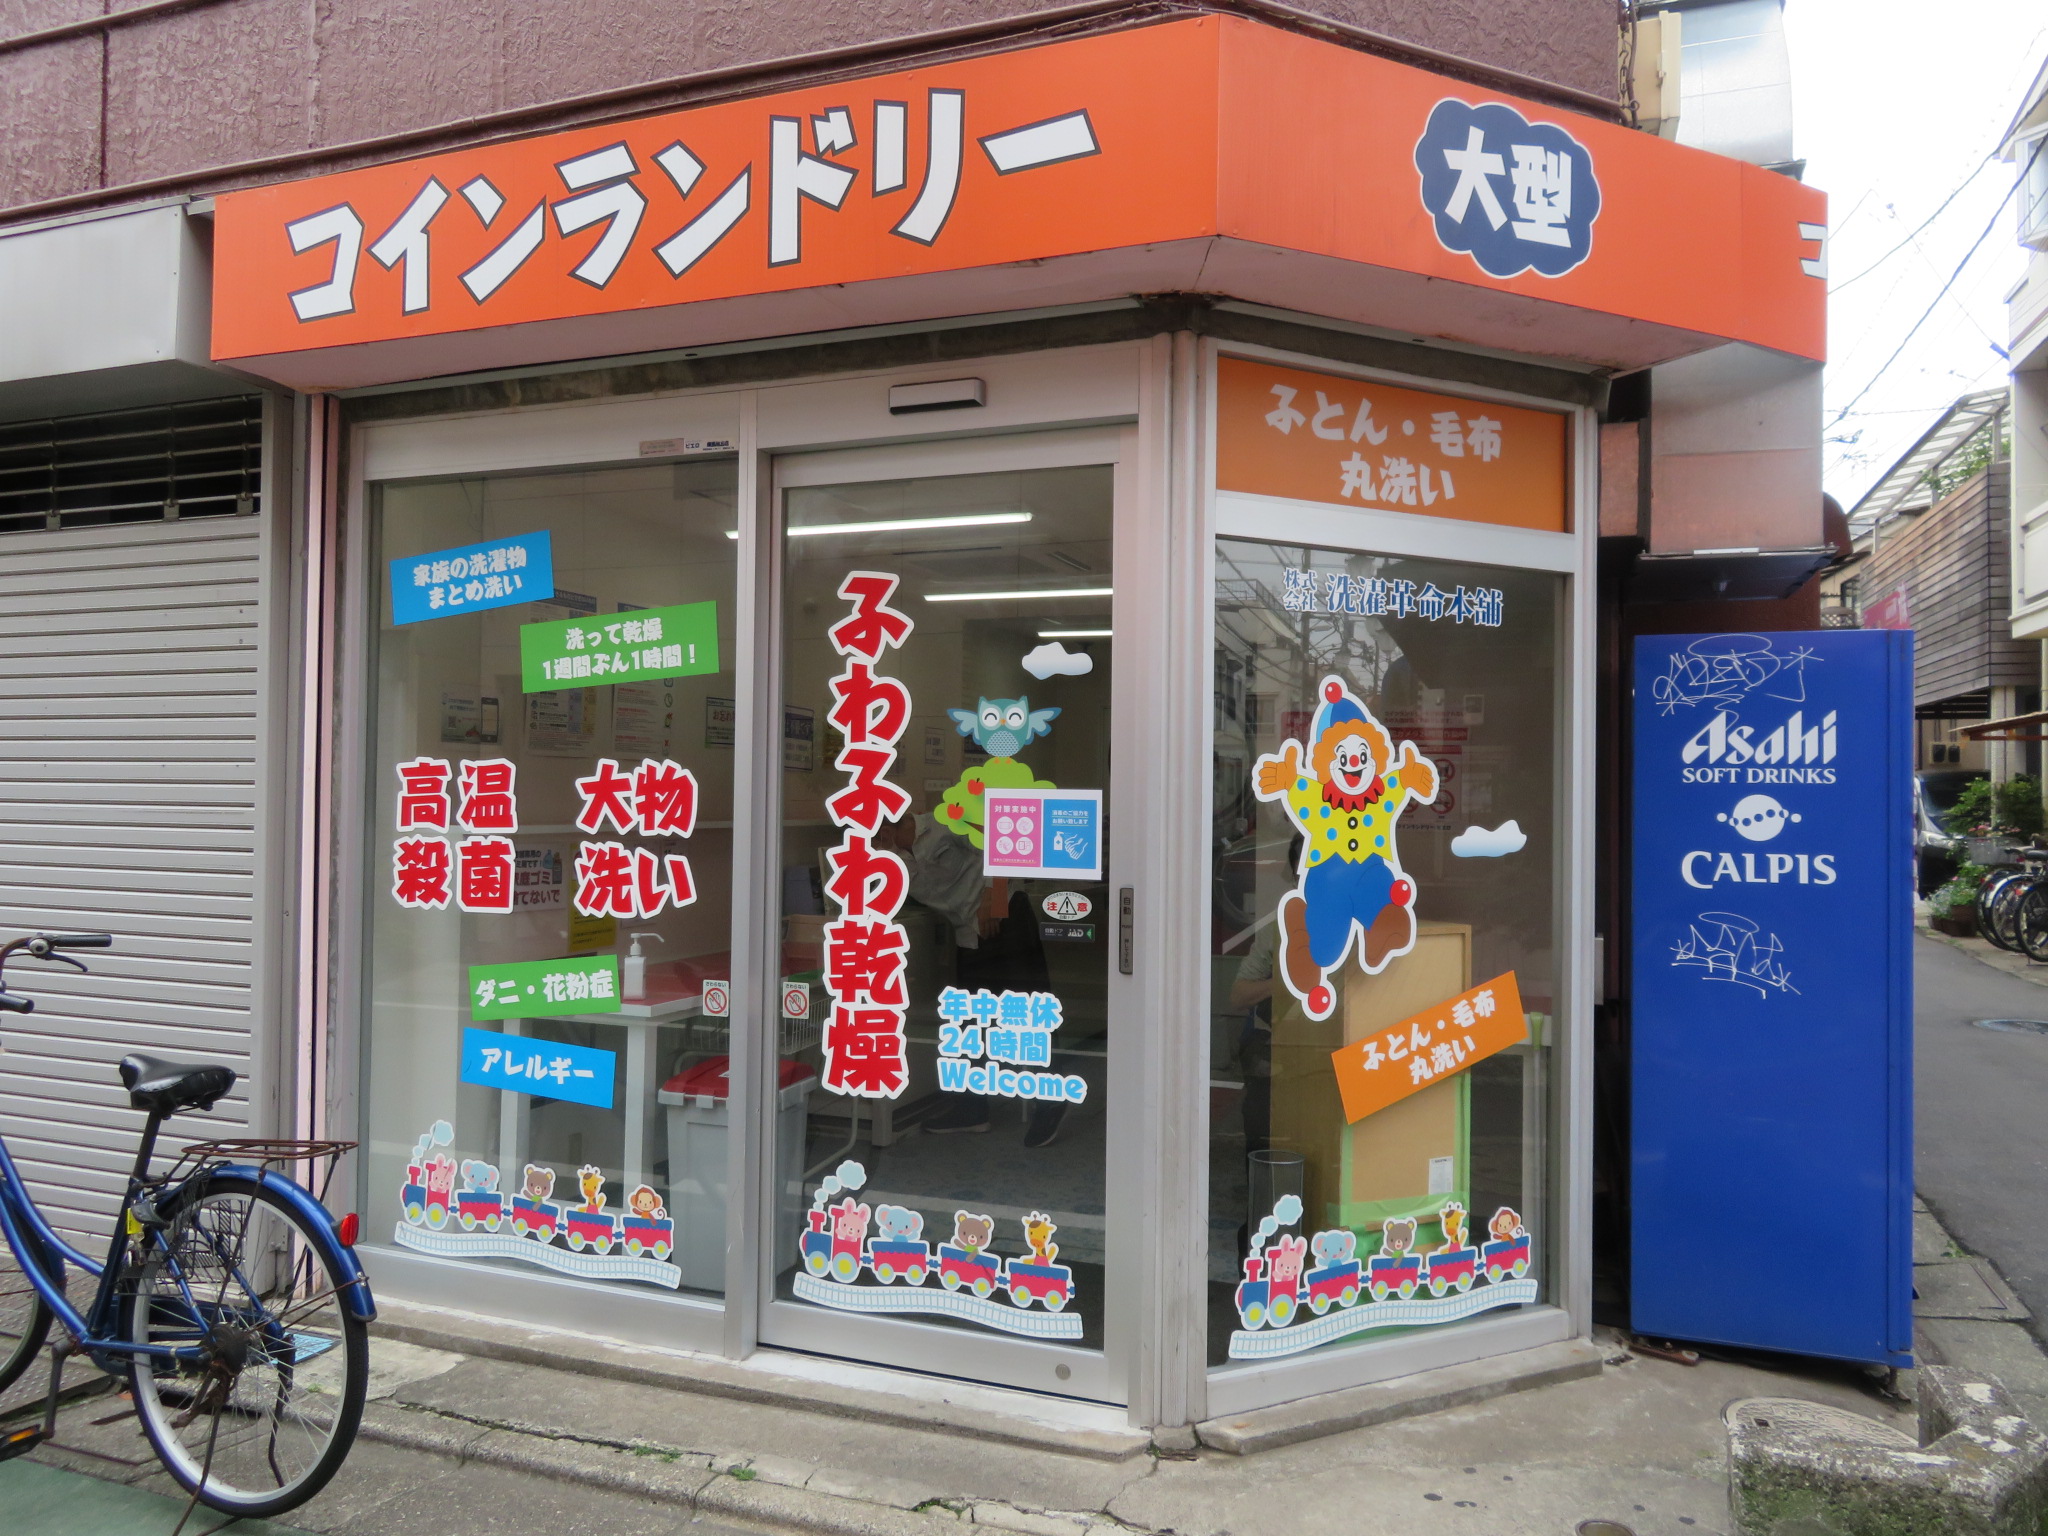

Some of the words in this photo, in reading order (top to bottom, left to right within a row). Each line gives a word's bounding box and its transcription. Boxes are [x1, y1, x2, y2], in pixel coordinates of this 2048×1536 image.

[284, 87, 1101, 323] コインランドリー
[1442, 125, 1572, 248] 大型
[1264, 383, 1503, 462] ふとん・毛布
[1339, 452, 1456, 506] 丸洗い
[413, 545, 528, 588] 家族の洗濯物
[428, 573, 523, 610] まとめ洗い
[1325, 573, 1504, 627] 洗濯革命本舗
[565, 617, 664, 650] 洗って乾燥
[1681, 709, 1837, 765] Asahi
[396, 757, 517, 834] 高温
[576, 758, 698, 838] 大物
[1682, 767, 1741, 784] SOFT
[1746, 767, 1837, 784] DRINKS
[823, 571, 915, 1100] ふわふわ乾燥
[393, 834, 516, 914] 殺菌
[574, 840, 698, 919] 洗い
[1681, 850, 1837, 890] CALPIS
[475, 969, 615, 1008] ダニ・花粉症
[938, 986, 1063, 1030] 年中無休
[1362, 988, 1496, 1072] ふとん・毛布
[480, 1046, 595, 1086] アレルギー
[937, 1056, 1088, 1105] Welcome
[1409, 1035, 1476, 1086] 丸洗い
